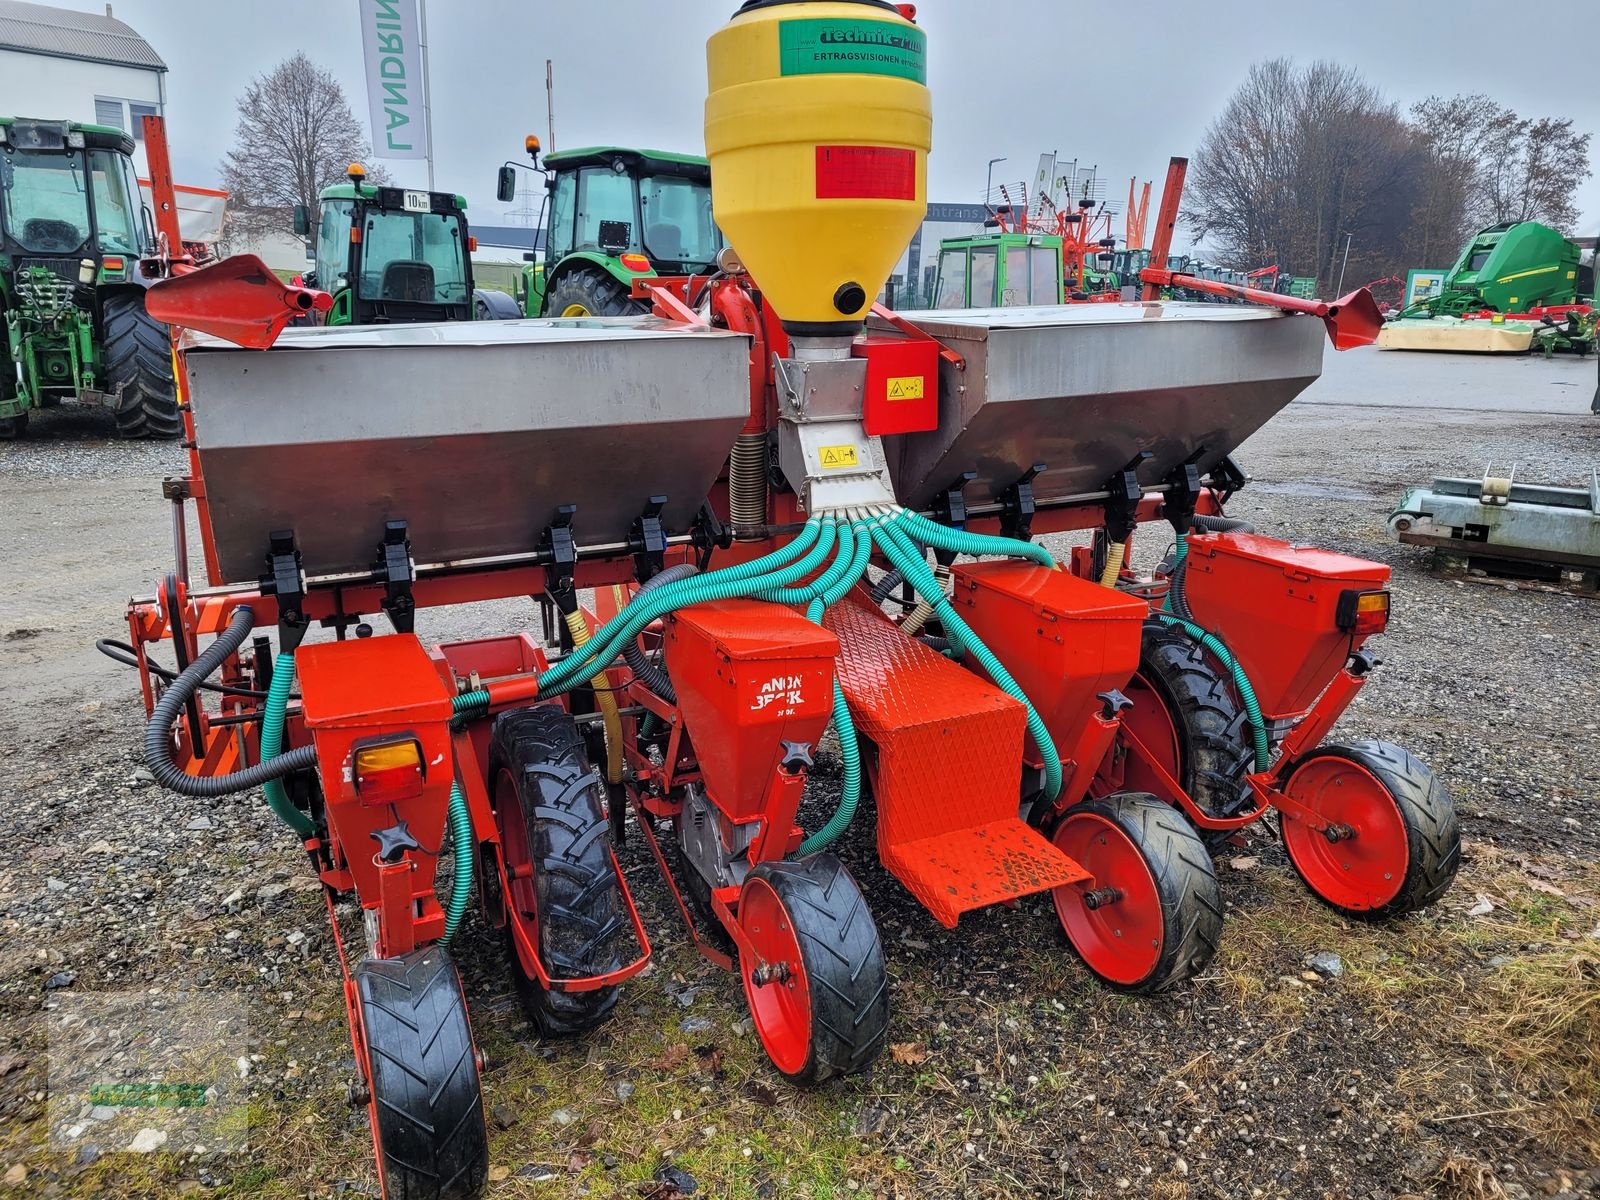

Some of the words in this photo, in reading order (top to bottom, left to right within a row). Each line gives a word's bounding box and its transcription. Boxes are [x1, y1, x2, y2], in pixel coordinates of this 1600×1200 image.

[814, 52, 900, 64] ERTRAGSVISIONEN
[408, 194, 418, 208] 10
[418, 199, 428, 209] km
